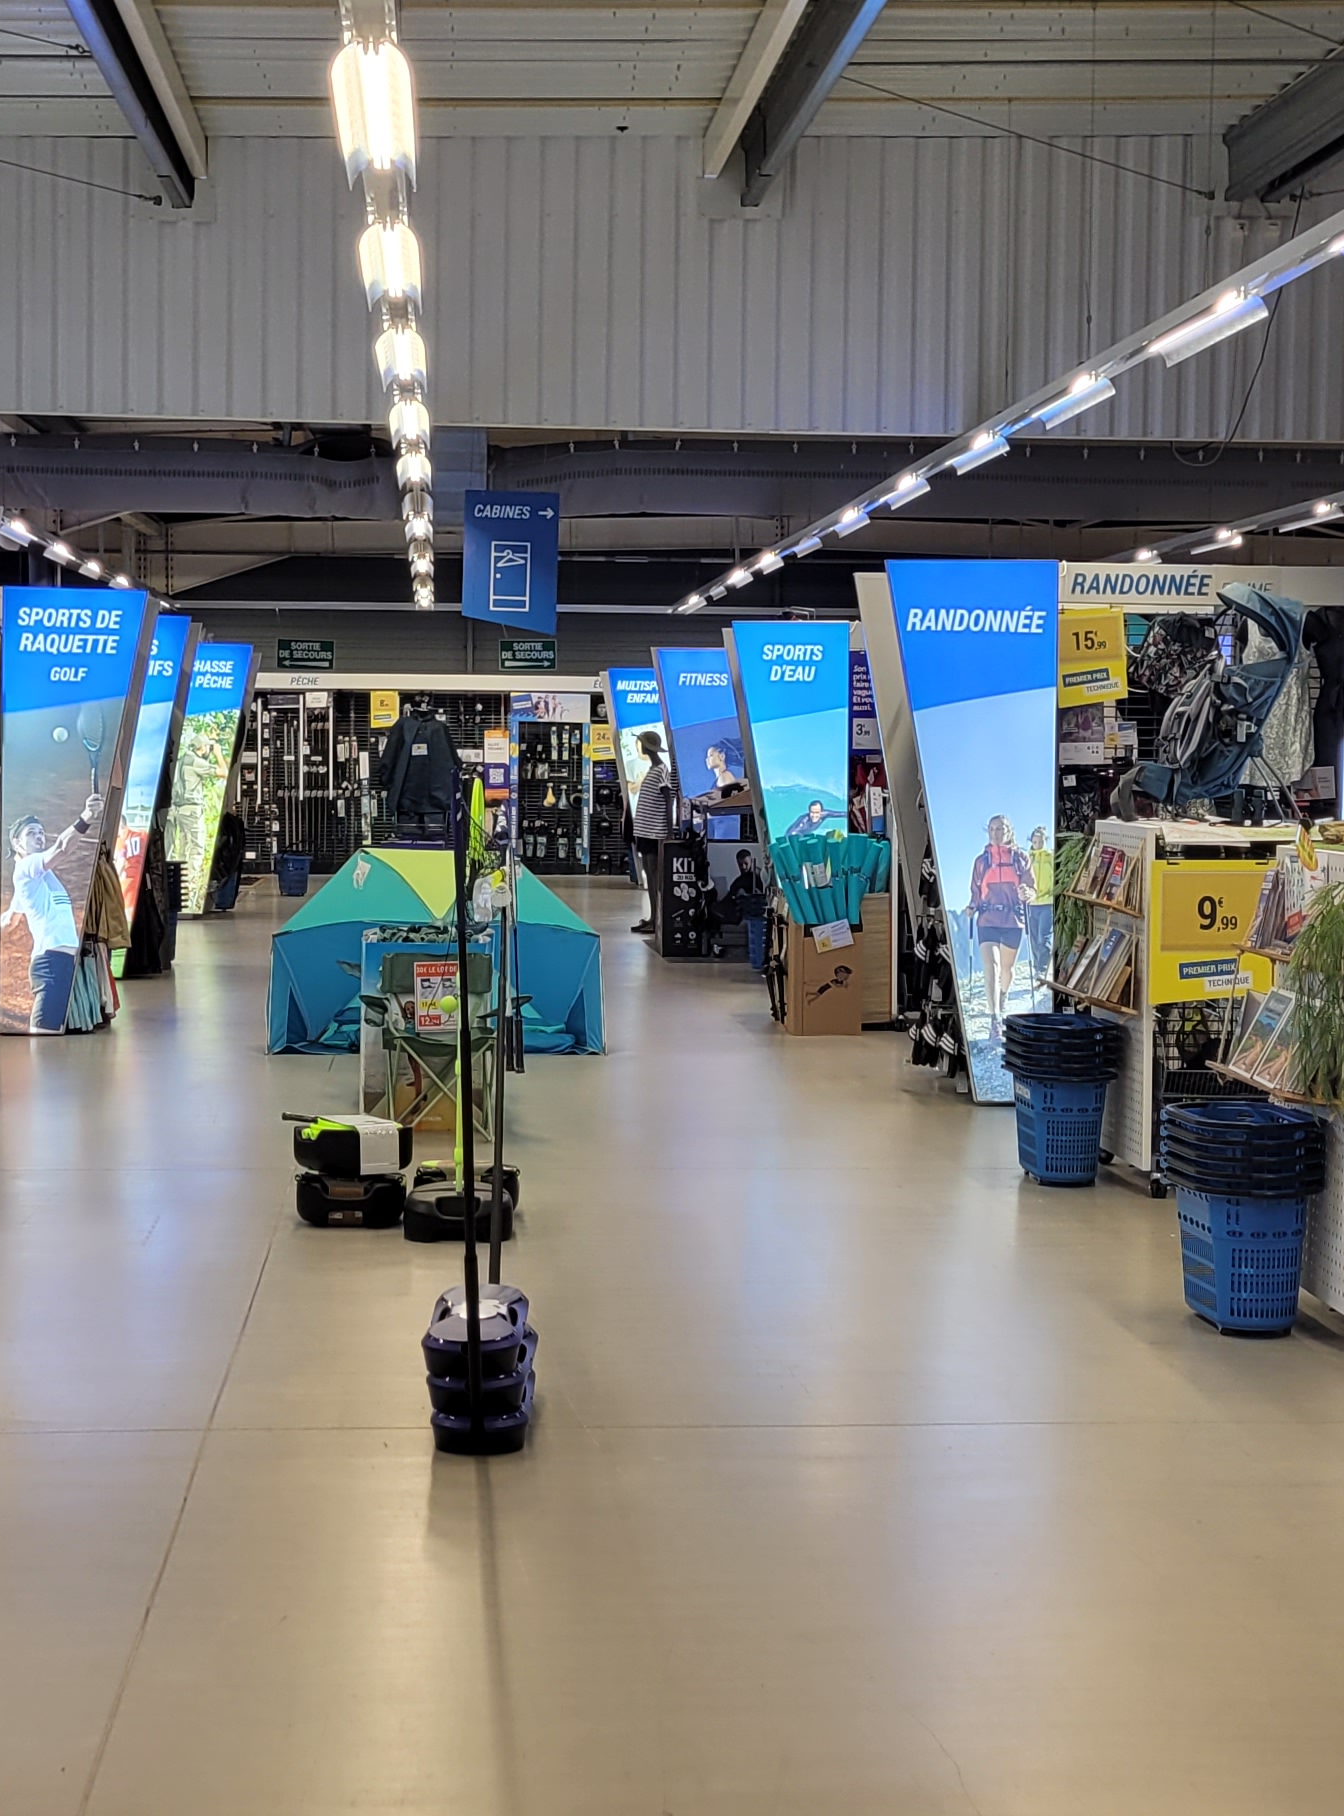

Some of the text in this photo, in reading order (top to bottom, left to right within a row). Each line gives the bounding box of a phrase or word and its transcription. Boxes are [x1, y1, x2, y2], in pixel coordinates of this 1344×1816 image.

[473, 503, 532, 520] CABINES
[1071, 568, 1214, 597] RANDONNÉE
[17, 606, 124, 630] SPORTS DE
[905, 605, 1048, 634] RANDONNÉE
[18, 632, 121, 656] RAQUETTE
[290, 641, 322, 651] SORTIE
[512, 642, 544, 652] SORTIE
[761, 643, 824, 662] SPORTS
[278, 650, 333, 660] DE SECOURS
[501, 651, 555, 660] DE SECOURS
[49, 666, 89, 683] GOLF
[194, 673, 235, 690] PÊCHE
[289, 675, 321, 687] PÊCHE
[678, 672, 729, 687] FITNESS
[769, 664, 817, 683] D'EAU
[1182, 962, 1236, 977] PREMIER PRIX
[1207, 975, 1251, 988] TECHNQUE
